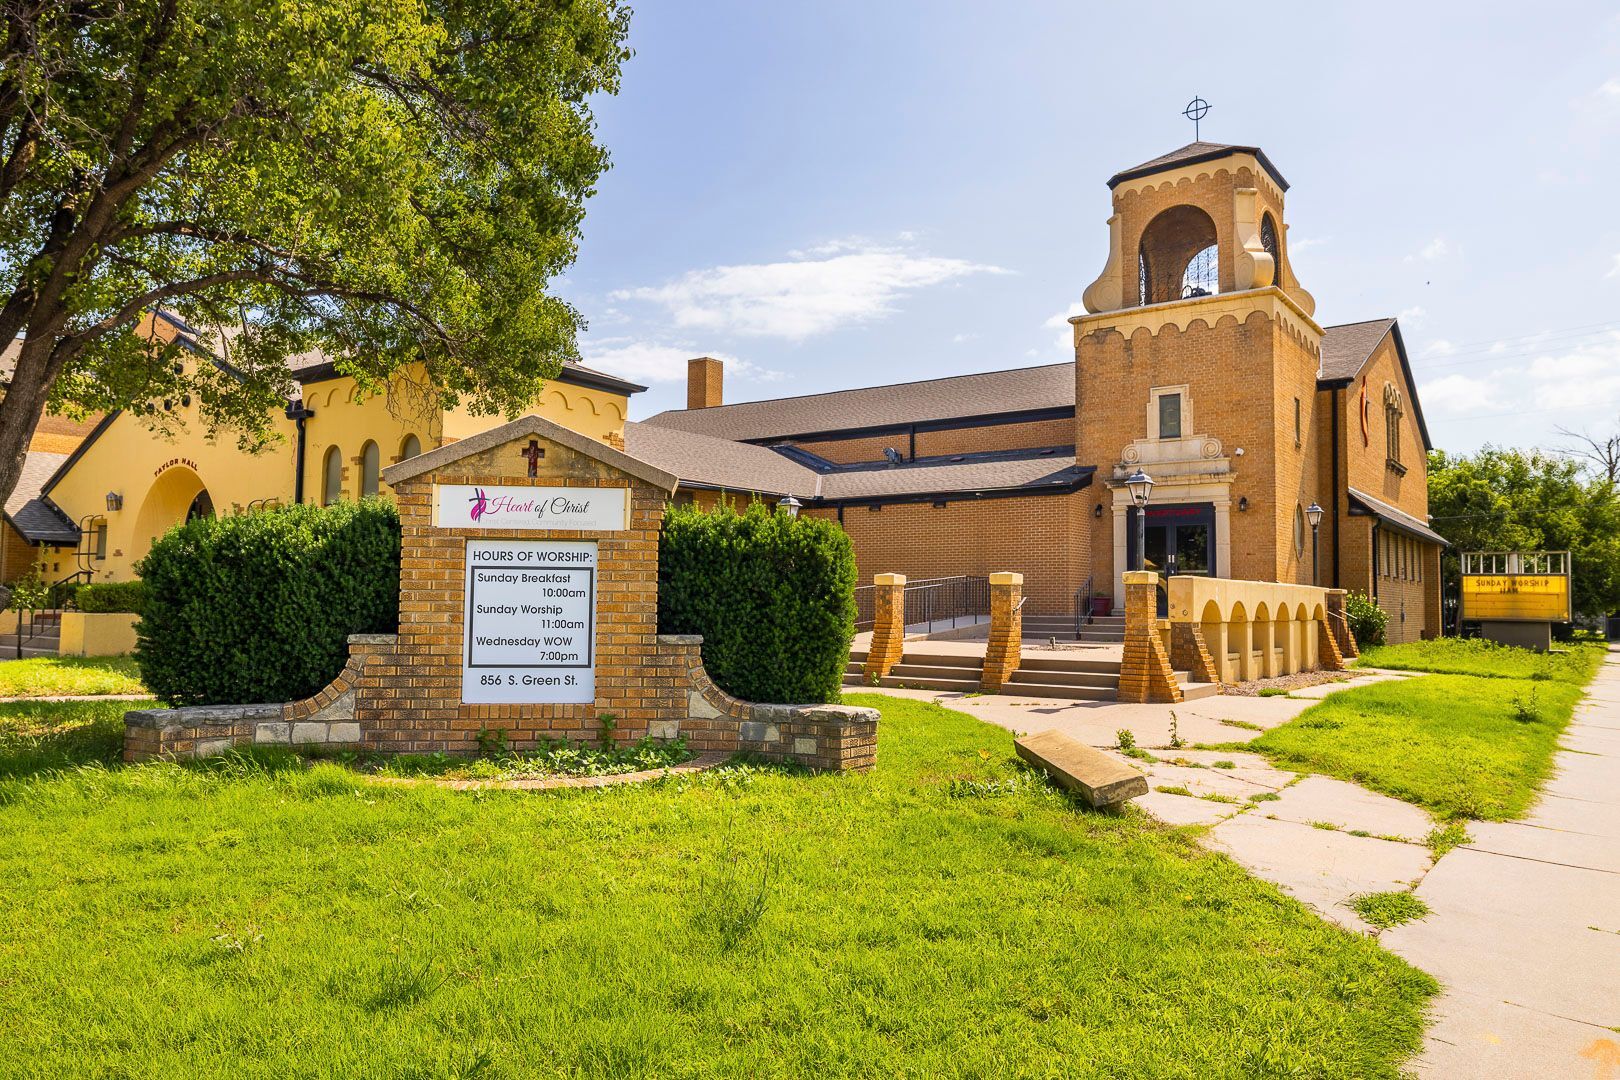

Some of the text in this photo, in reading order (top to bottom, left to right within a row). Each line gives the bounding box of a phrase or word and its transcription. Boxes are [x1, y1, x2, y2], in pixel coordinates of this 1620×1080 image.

[154, 458, 198, 477] TAYLOR HALL
[484, 495, 590, 519] Heart of Christ
[473, 550, 593, 563] HOURS OF WORSHIP:
[477, 573, 571, 584] Sunday Breakfast
[1475, 579, 1507, 587] SUNDAY
[542, 588, 586, 598] 10:00am
[476, 604, 563, 617] Sunday Worship
[541, 620, 584, 629] 11:00am
[475, 636, 573, 648] Wednesday WOW
[540, 651, 578, 662] 7:00pm
[480, 675, 578, 686] 856 S. Green St.
